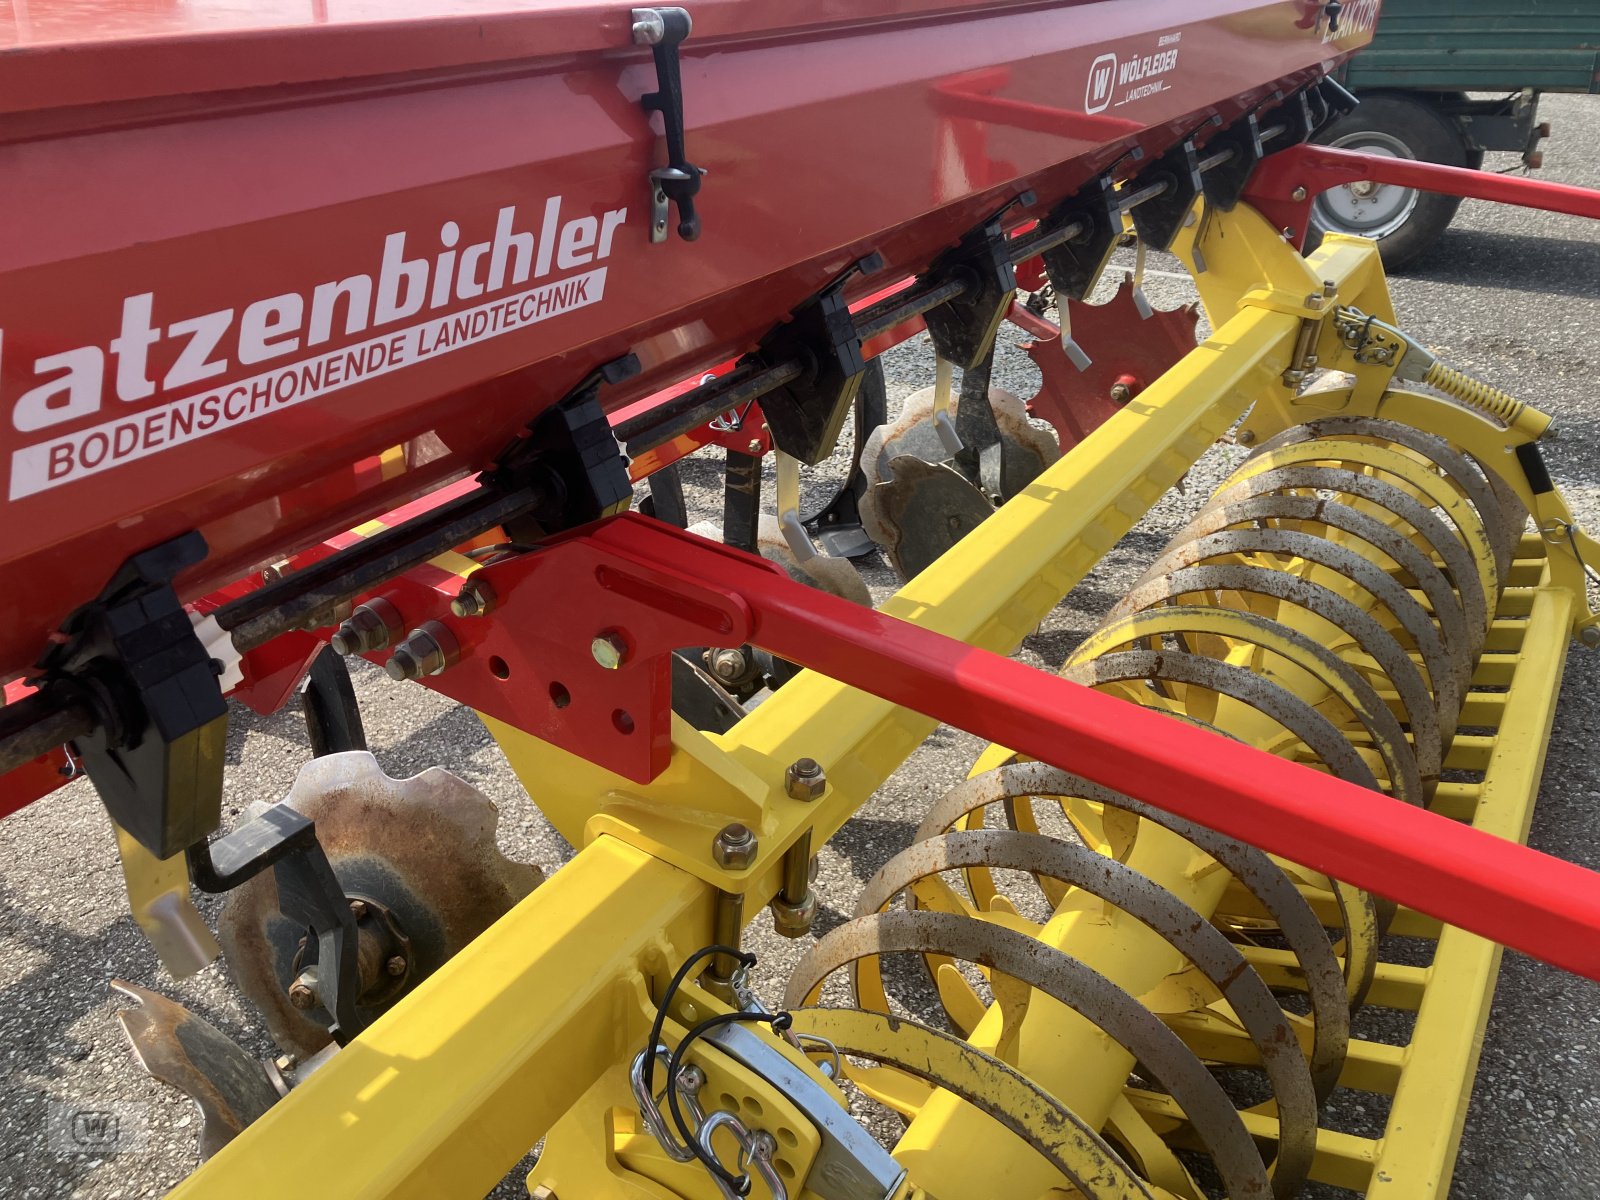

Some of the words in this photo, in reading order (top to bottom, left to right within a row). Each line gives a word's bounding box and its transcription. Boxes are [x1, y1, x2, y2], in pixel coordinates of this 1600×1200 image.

[1094, 67, 1111, 101] W
[1119, 49, 1178, 85] WÖLFLEDER
[1125, 79, 1164, 103] LANDTECHNIK
[0, 195, 628, 433] atzenbichler
[48, 334, 407, 481] BODENSCHONENDE
[417, 276, 591, 357] LANDTECHNIK
